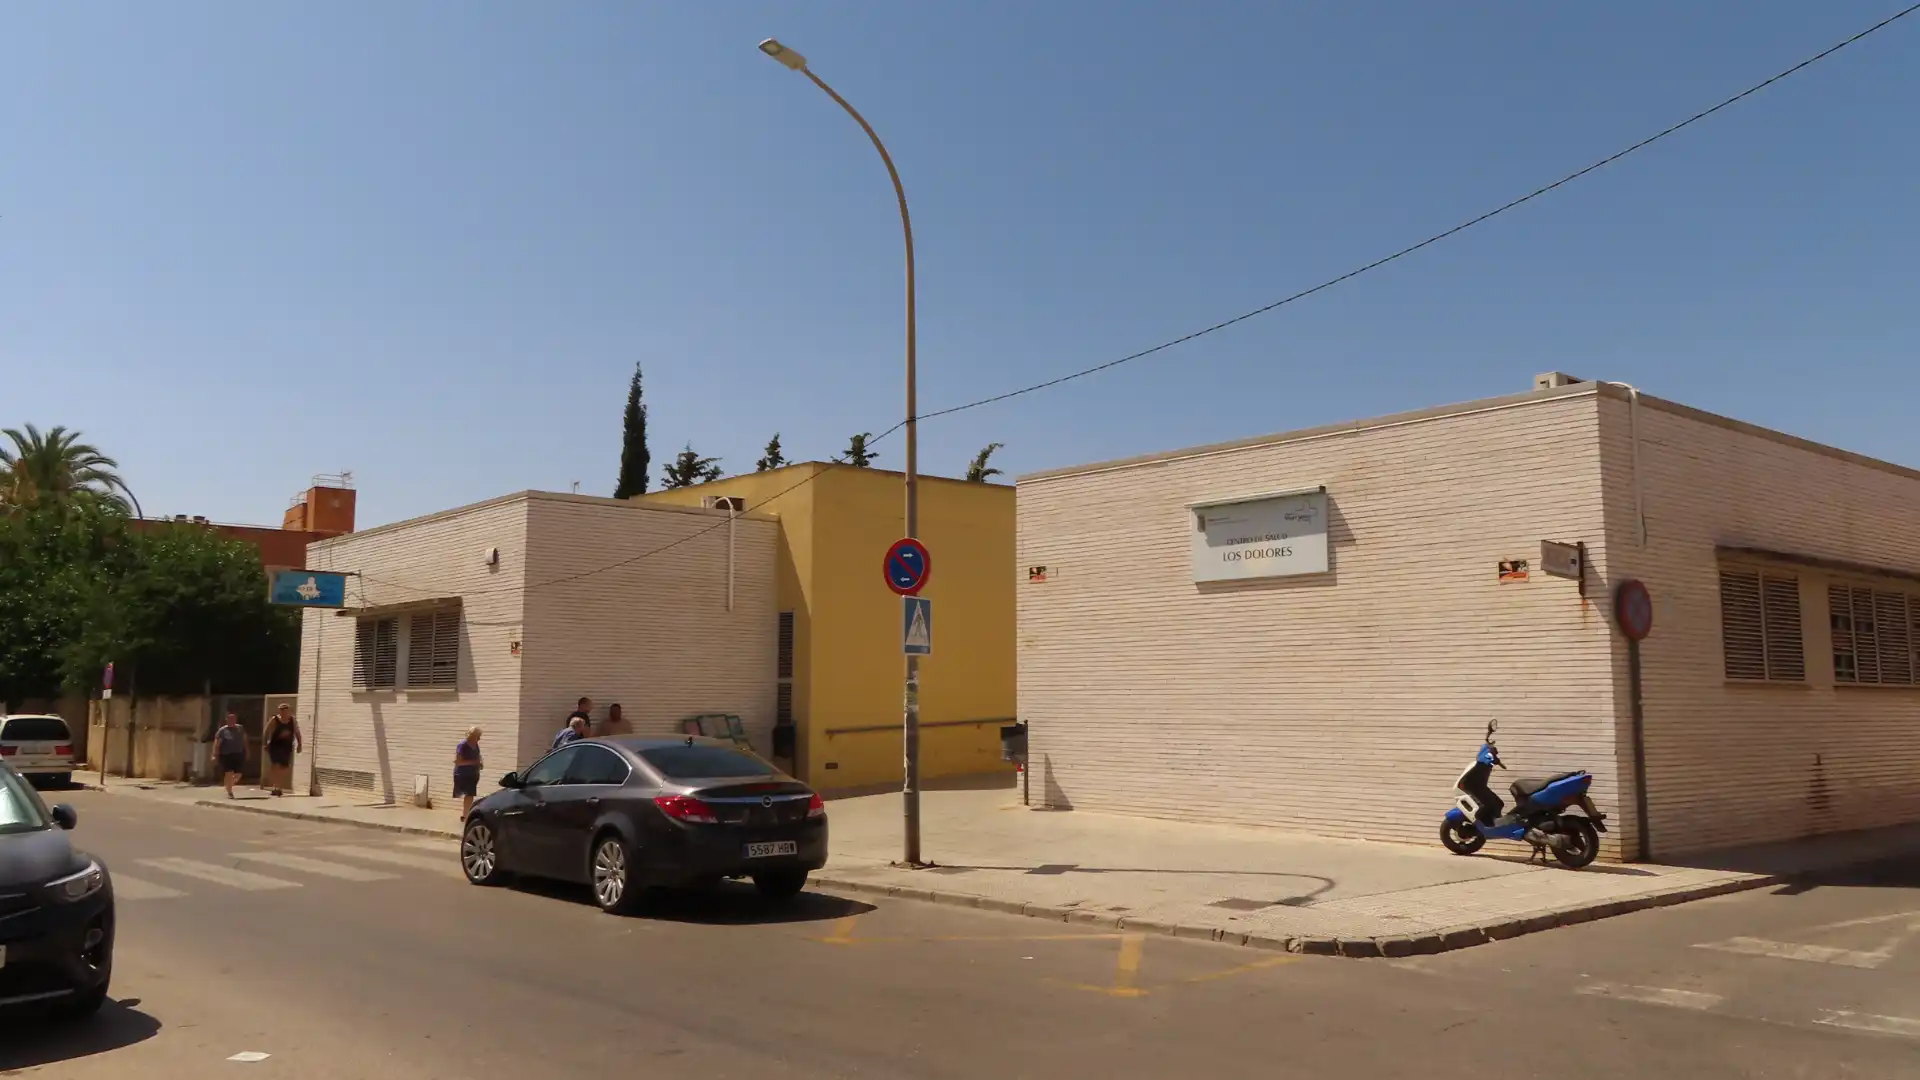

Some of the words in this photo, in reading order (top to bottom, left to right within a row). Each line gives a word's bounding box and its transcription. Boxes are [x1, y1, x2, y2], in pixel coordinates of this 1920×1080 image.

[1226, 536, 1253, 545] CENTRO
[1264, 532, 1288, 541] SALUD
[1223, 550, 1242, 562] LOS
[1244, 546, 1293, 560] DOLORES
